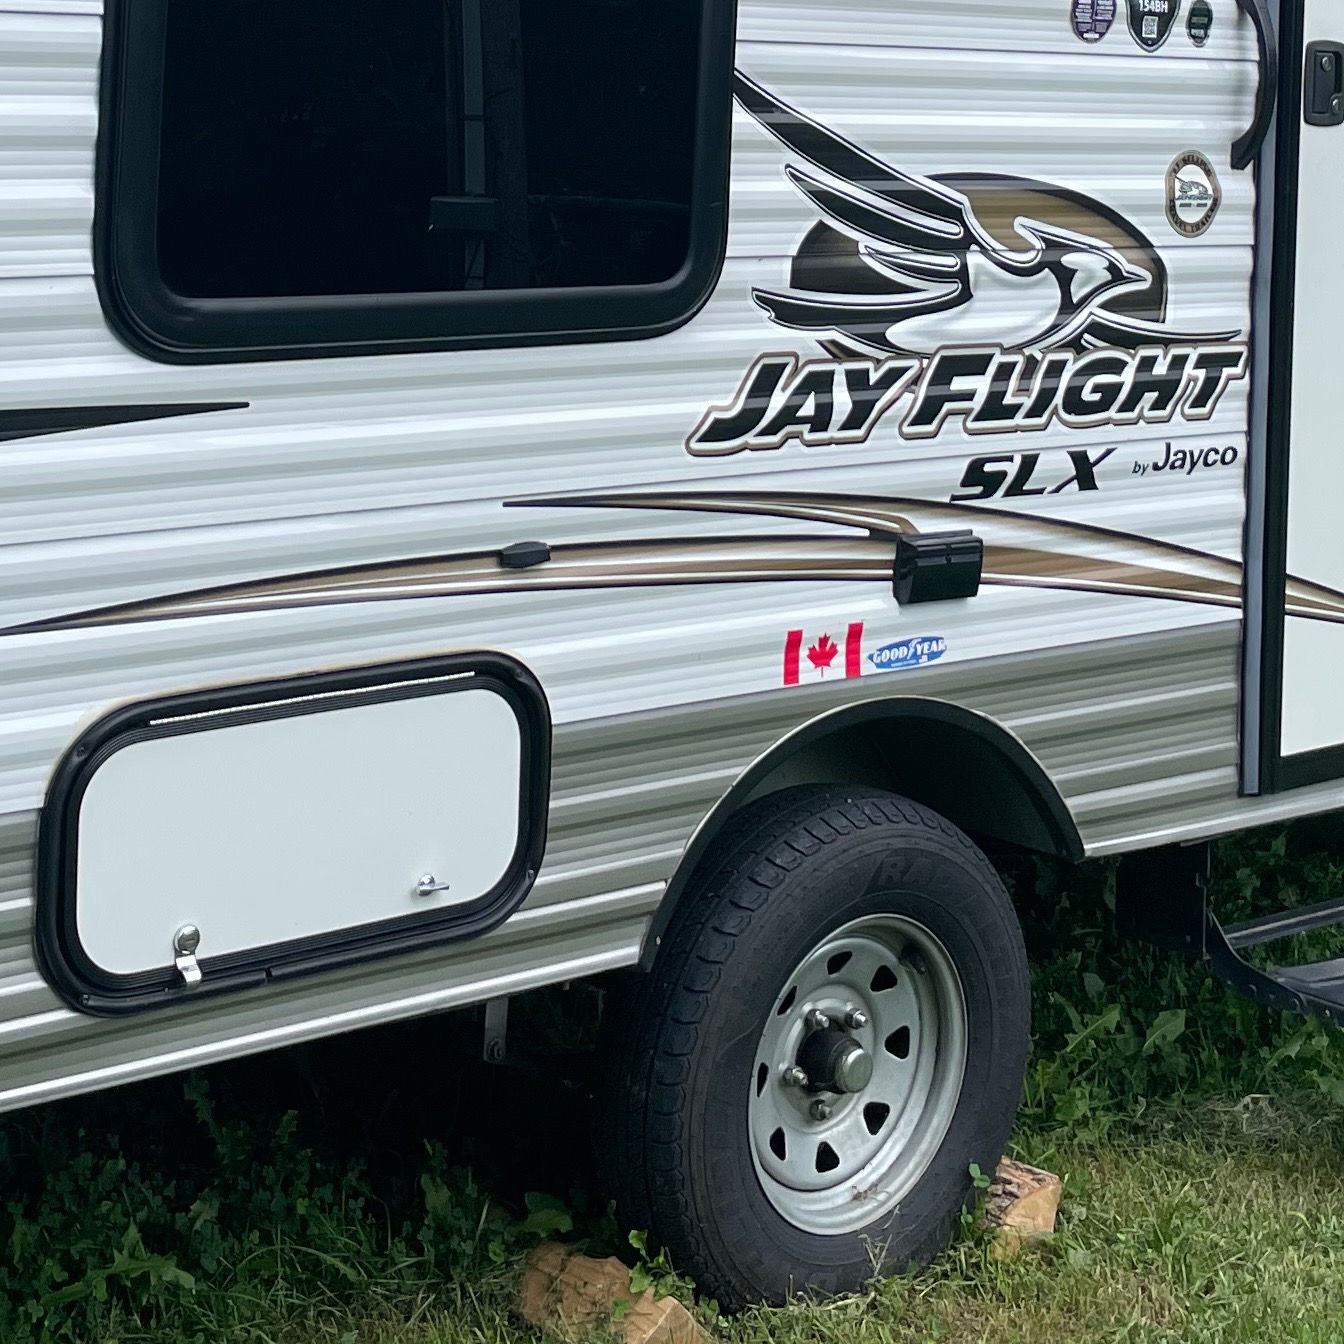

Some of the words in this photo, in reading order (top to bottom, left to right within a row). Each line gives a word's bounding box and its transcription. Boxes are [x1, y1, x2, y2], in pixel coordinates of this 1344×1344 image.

[1138, 0, 1169, 13] 154BH
[686, 351, 921, 457] JAY
[898, 341, 1249, 440] FLIGHT
[949, 447, 1118, 503] SLX
[1131, 460, 1150, 476] by
[1152, 442, 1238, 475] Jayco
